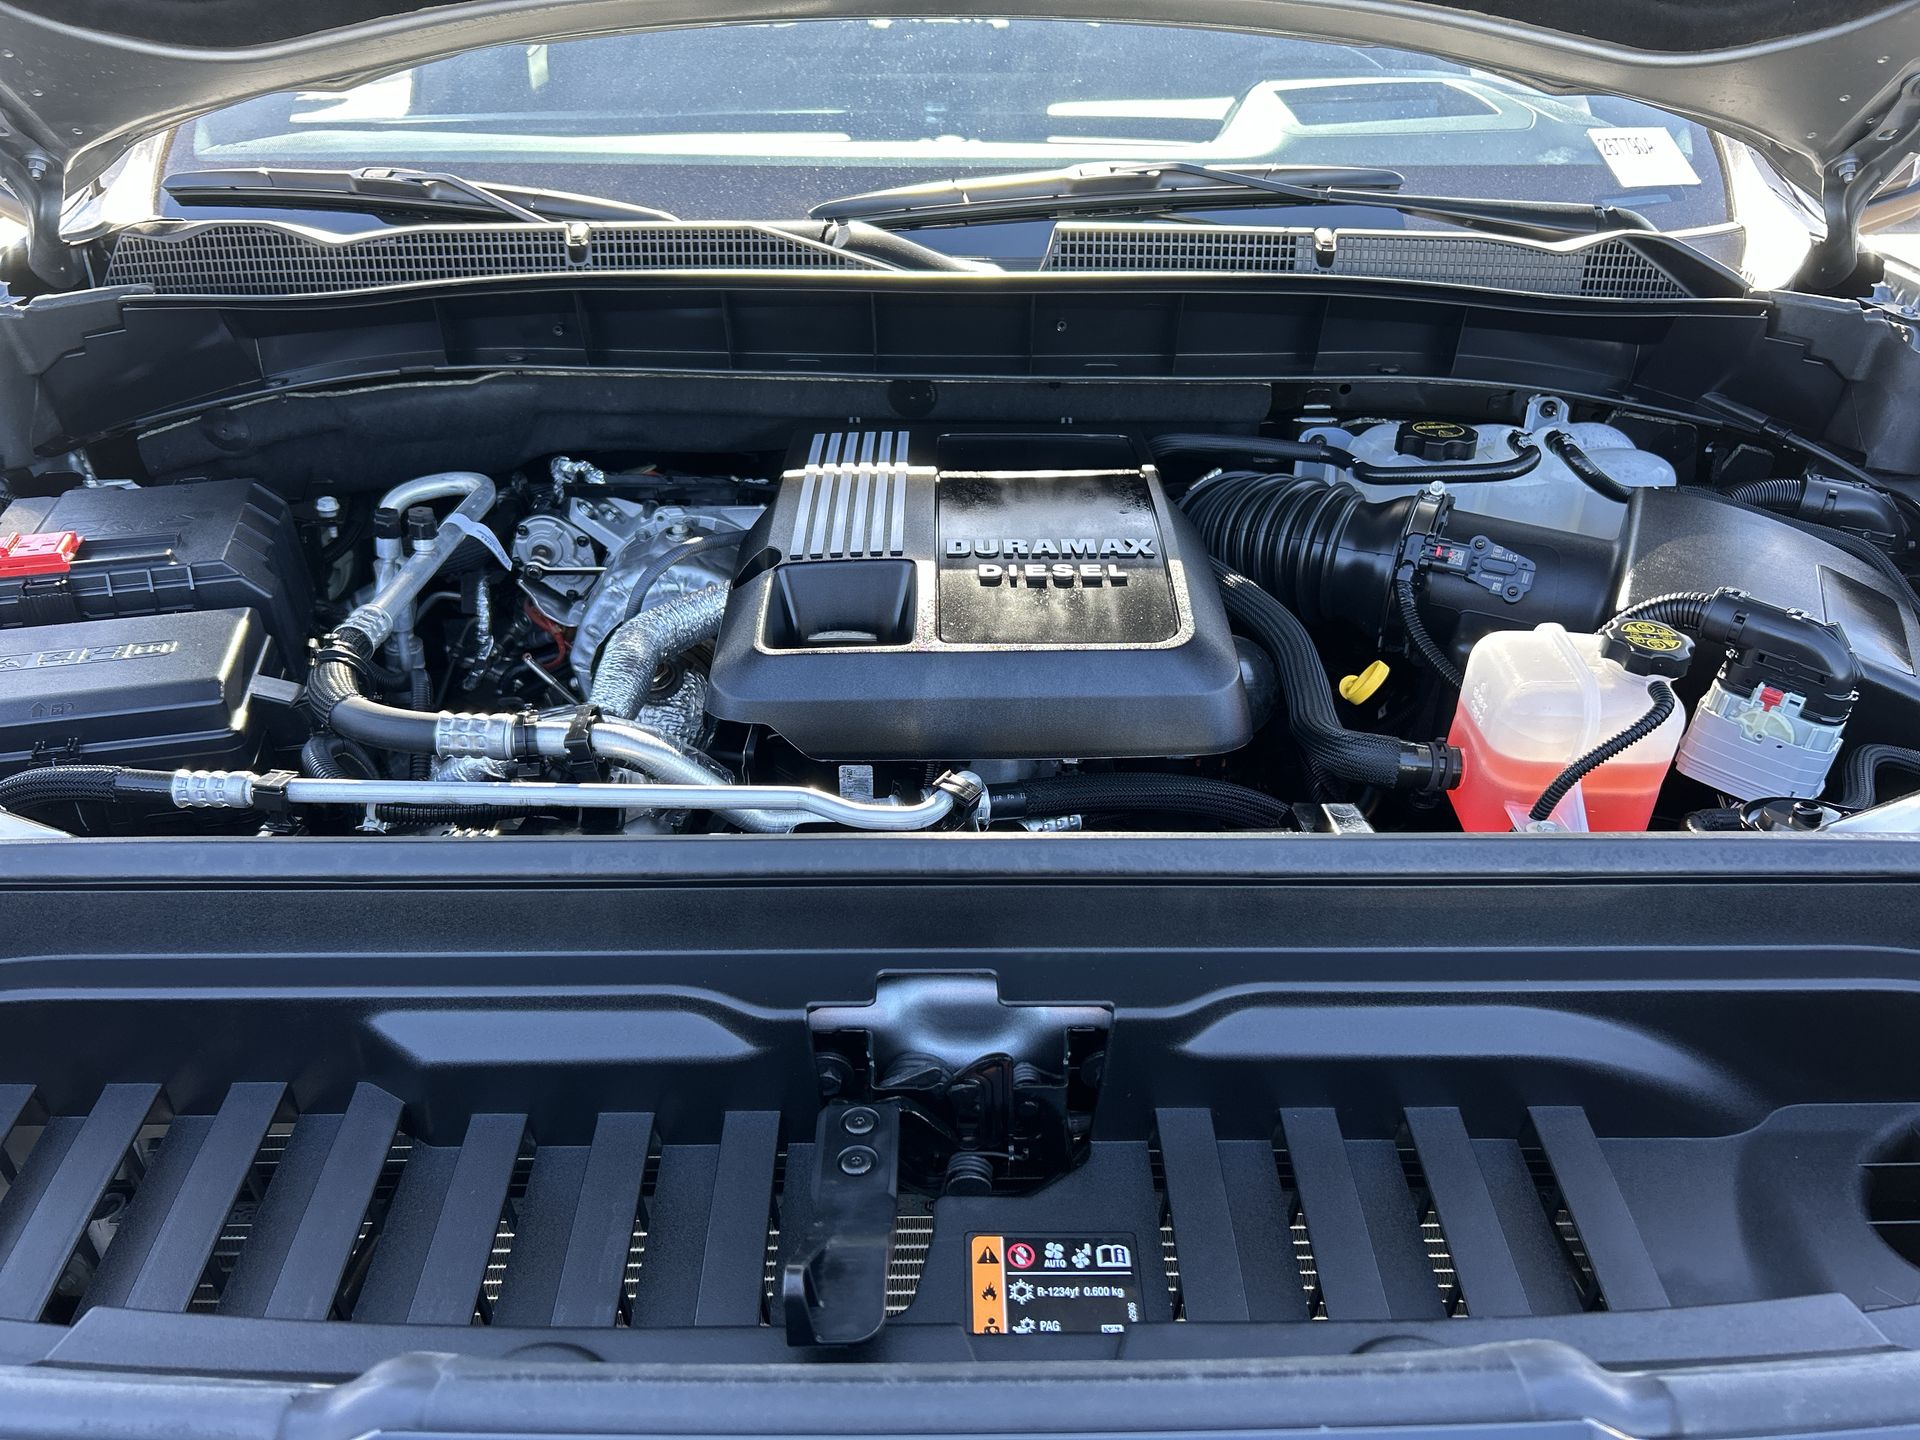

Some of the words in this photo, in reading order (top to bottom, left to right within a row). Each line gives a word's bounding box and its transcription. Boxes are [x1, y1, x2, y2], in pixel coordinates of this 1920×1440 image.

[946, 538, 1155, 559] DURAMAX
[978, 564, 1128, 582] DIESEL
[1044, 1259, 1067, 1268] AUTO
[1037, 1286, 1080, 1298] R-1234yf
[1083, 1286, 1110, 1297] 0.600
[1111, 1286, 1124, 1298] kg
[1040, 1320, 1061, 1331] PAG
